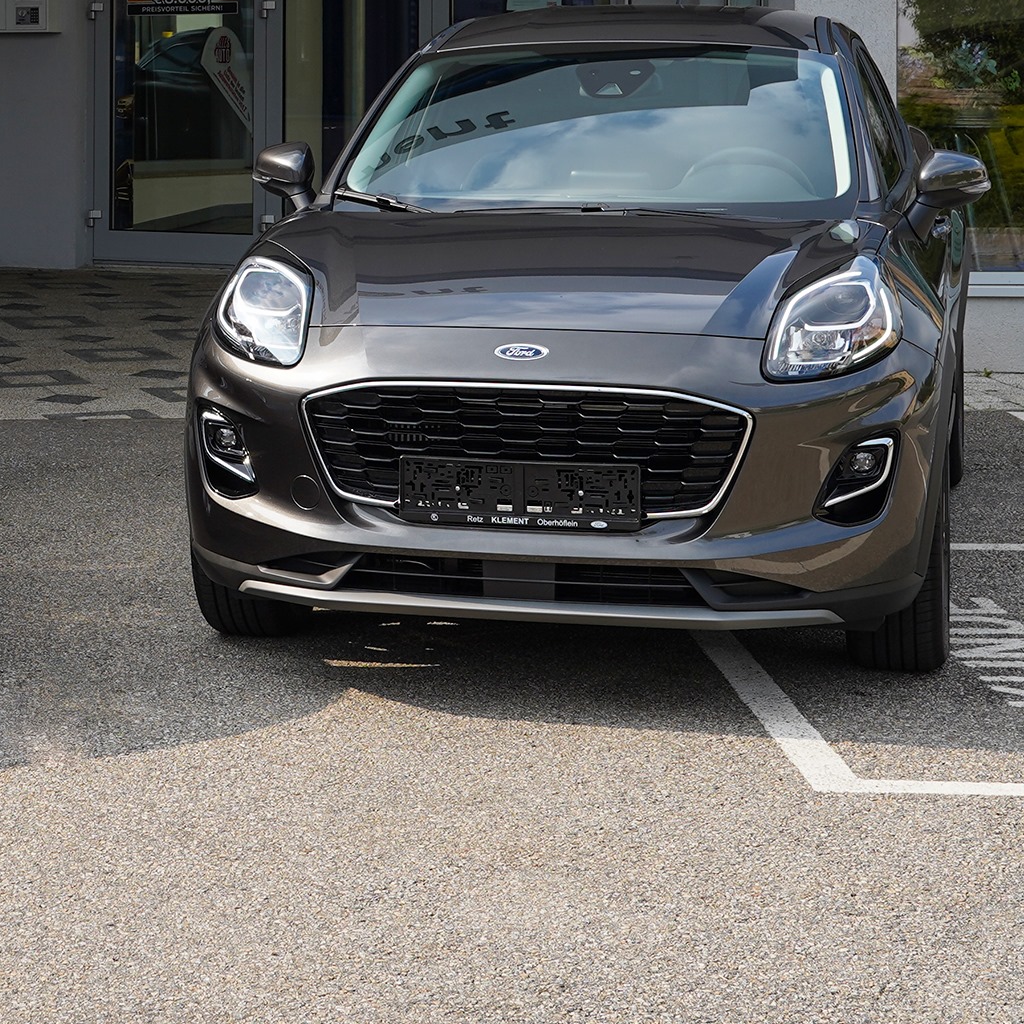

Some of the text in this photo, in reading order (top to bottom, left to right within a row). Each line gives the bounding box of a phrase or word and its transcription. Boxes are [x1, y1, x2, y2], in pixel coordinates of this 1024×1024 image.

[142, 5, 189, 13] PREISVORTEIL
[505, 346, 536, 357] Ford
[466, 515, 578, 528] Retz KLEMENT Oberhöflein
